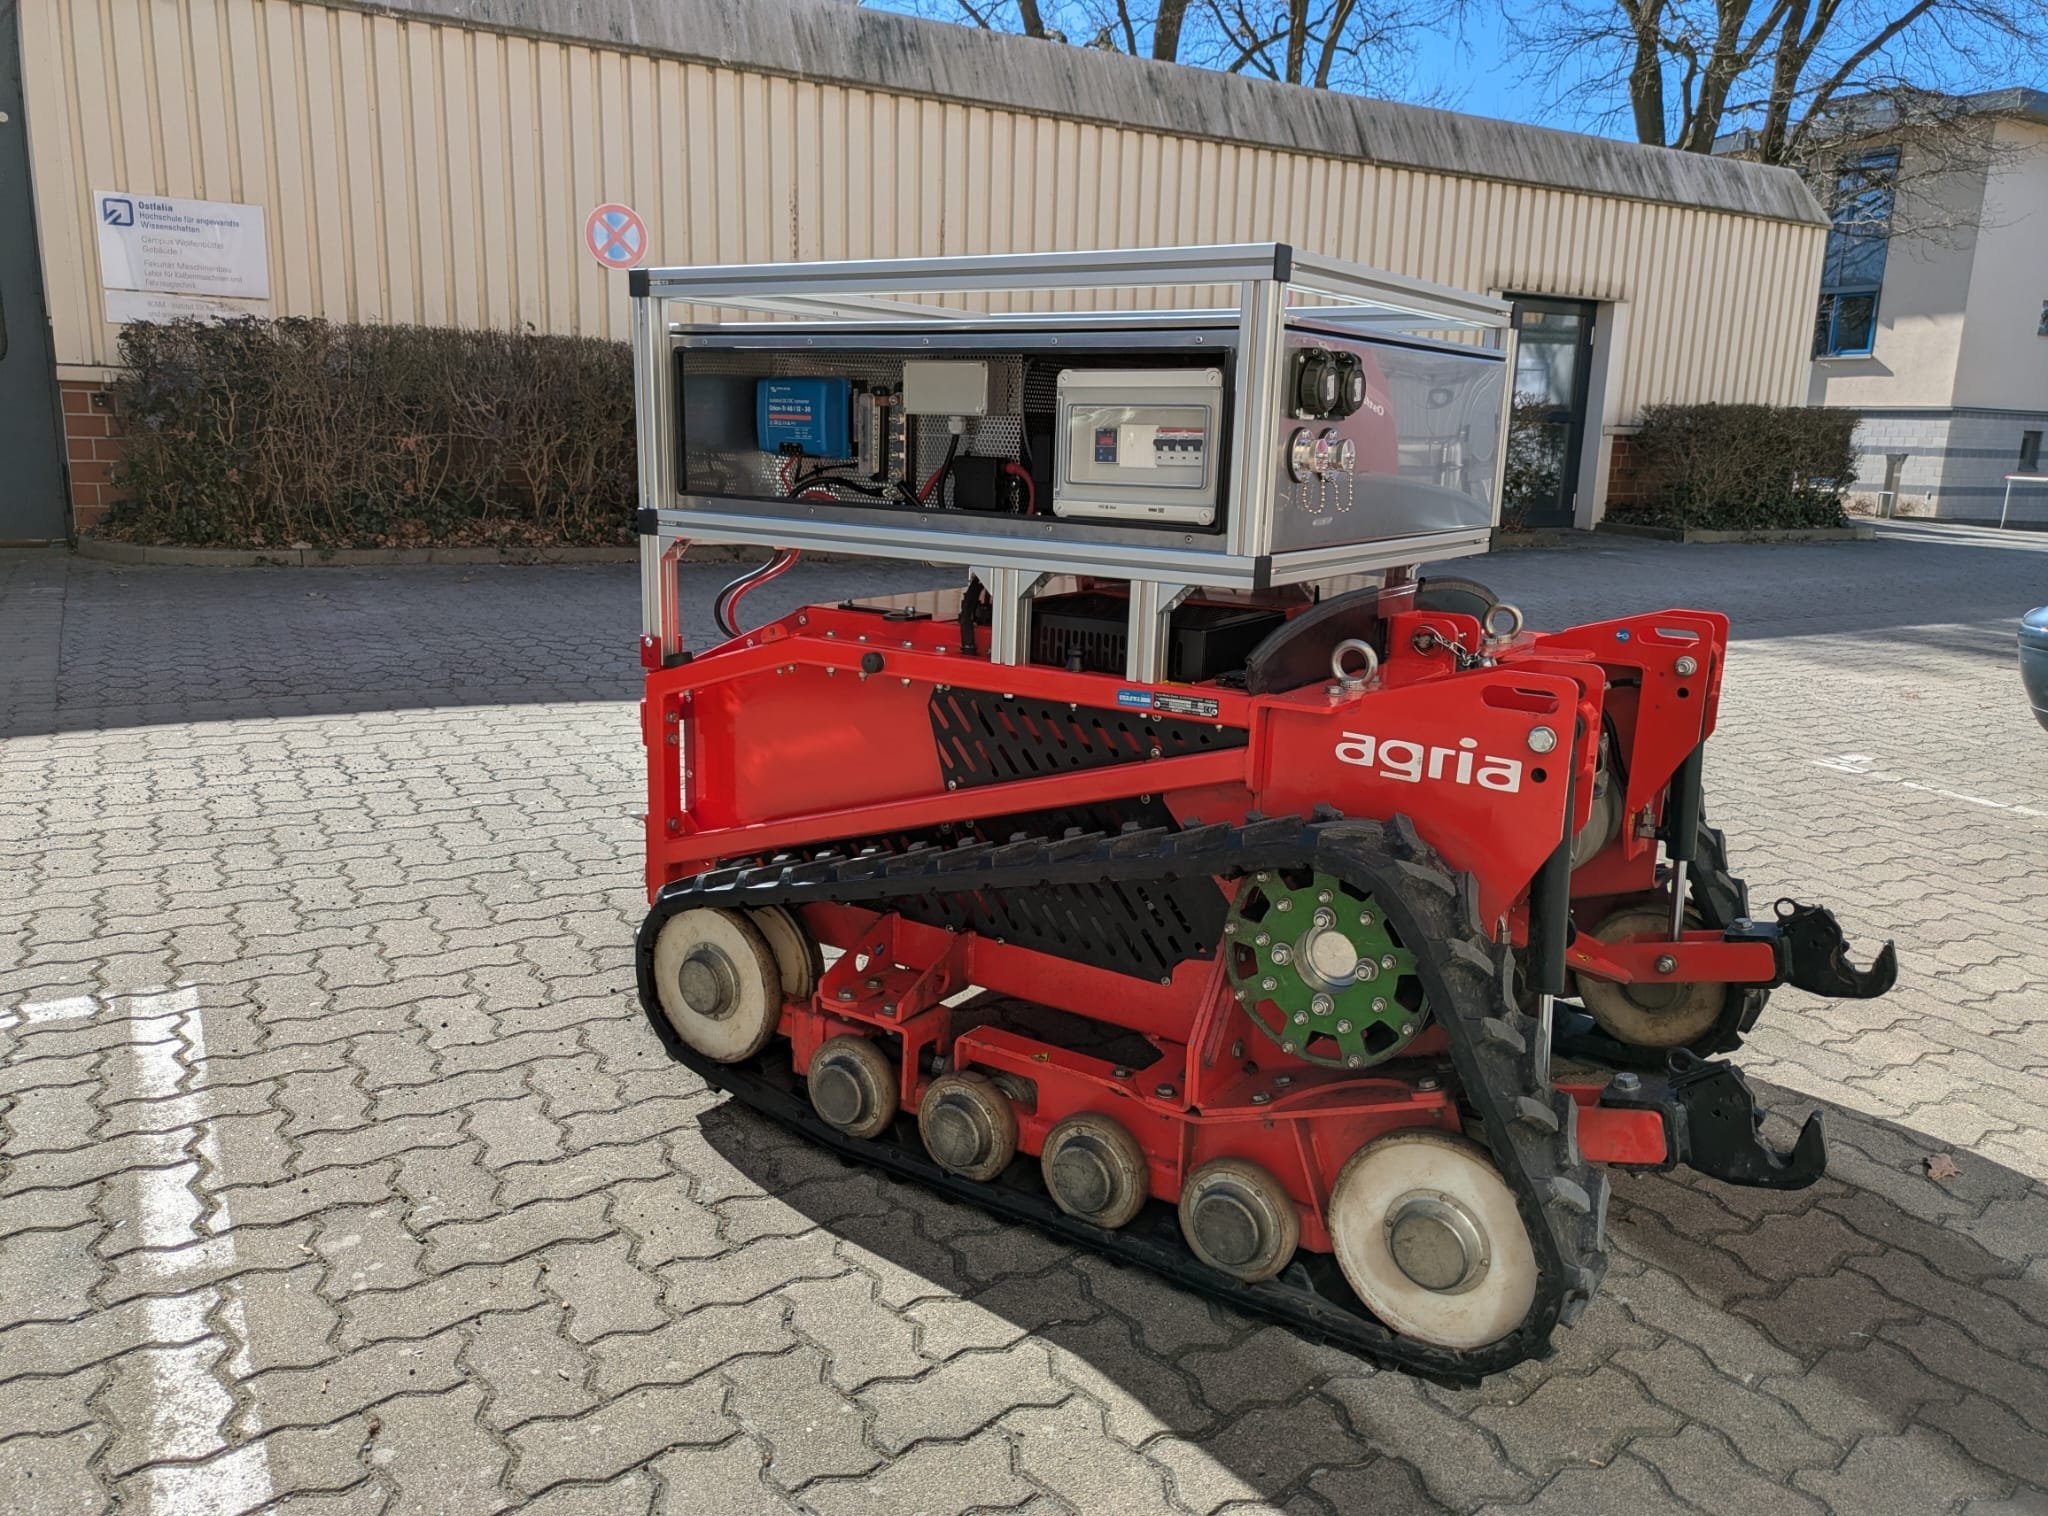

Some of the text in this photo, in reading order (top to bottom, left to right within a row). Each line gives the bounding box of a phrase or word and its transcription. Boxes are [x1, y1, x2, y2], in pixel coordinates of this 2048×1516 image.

[138, 201, 173, 212] Ostfalia
[139, 212, 240, 228] Hochschule für angewandte
[140, 221, 201, 233] Wissenschaften
[141, 236, 174, 246] Campus
[1335, 731, 1522, 793] agria
